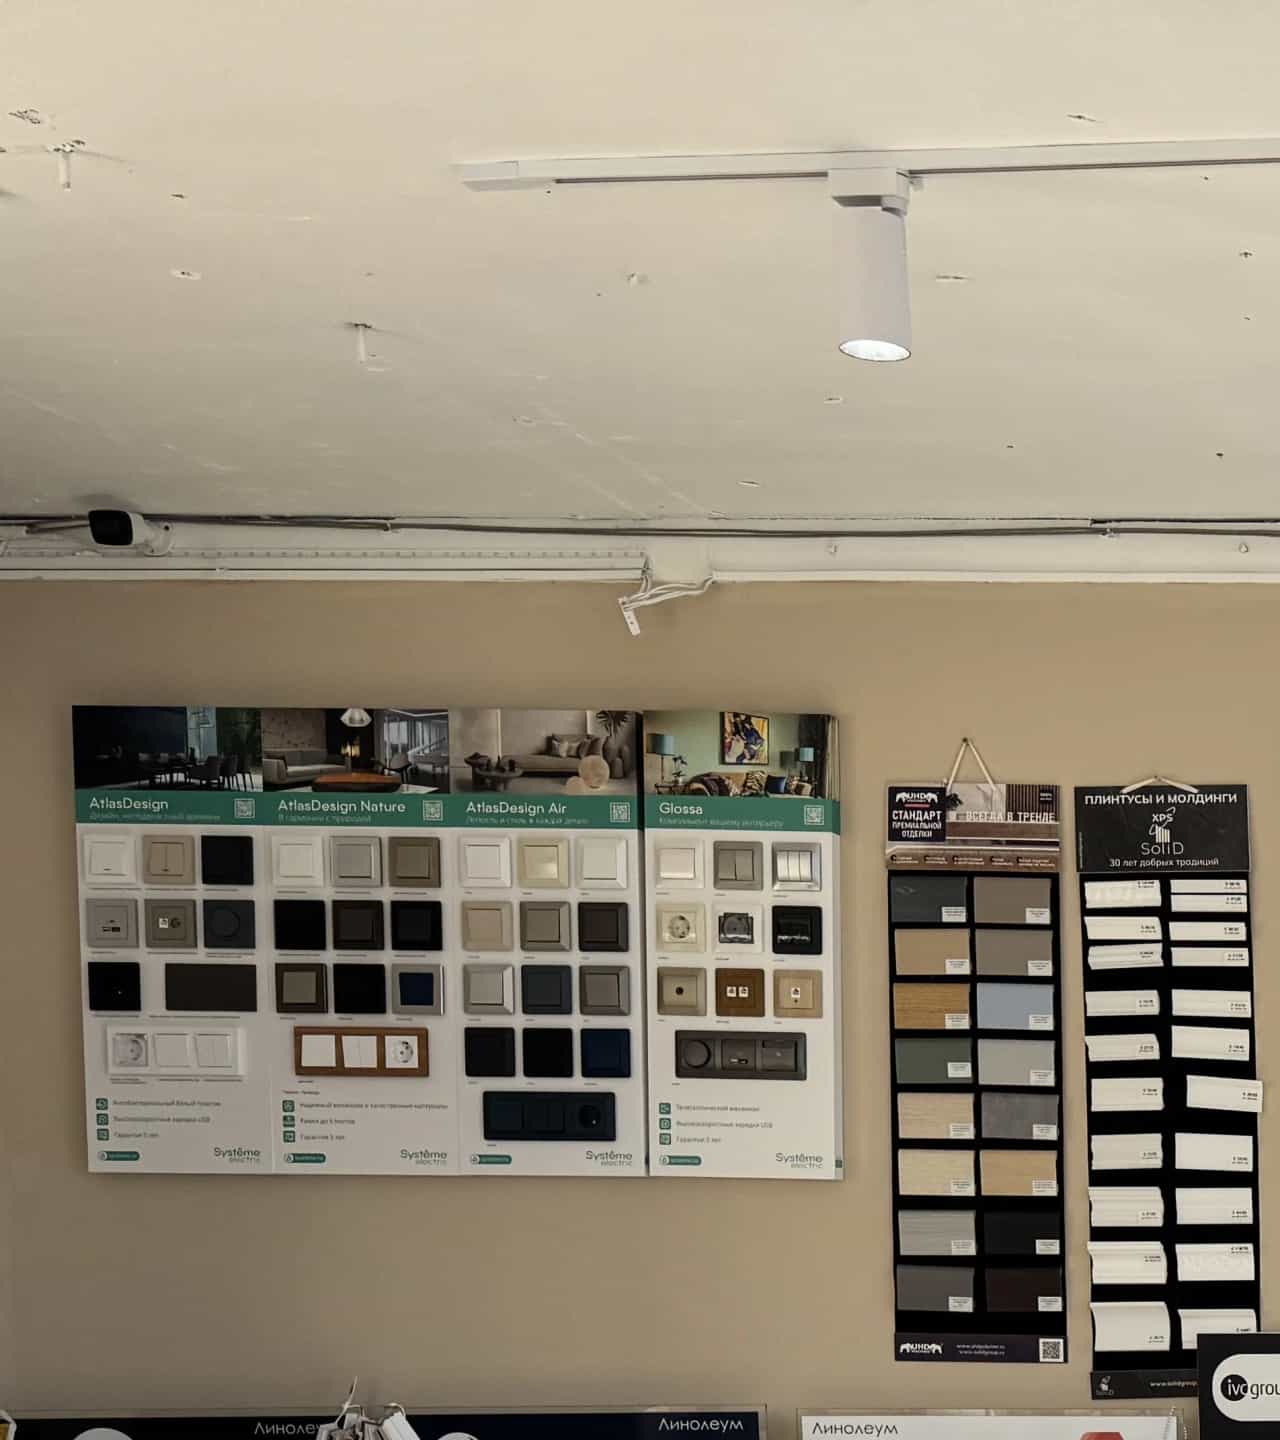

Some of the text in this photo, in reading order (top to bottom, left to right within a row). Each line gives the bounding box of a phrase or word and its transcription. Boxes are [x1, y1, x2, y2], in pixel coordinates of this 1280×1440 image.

[88, 797, 169, 812] AtlasDesign
[1084, 793, 1238, 806] ПЛИНТУСЫ И МОЛДИНГИ
[277, 799, 406, 814] AtlasDesign Nature
[465, 801, 568, 816] AtlasDesign Air
[658, 803, 704, 816] Glossa
[892, 810, 942, 821] СТАНДАРТ
[1007, 811, 1017, 822] В
[1018, 812, 1056, 823] ТРЕНДЕ
[1151, 813, 1174, 822] XPS
[892, 821, 942, 830] ПРЕМИАЛЬНОЙ
[901, 830, 933, 839] ОТДЕЛКИ
[1109, 857, 1219, 869] 30 лет добрых традиций
[254, 1421, 321, 1438] Линолеу
[657, 1416, 745, 1433] Линолеум
[811, 1421, 899, 1438] Линолеум
